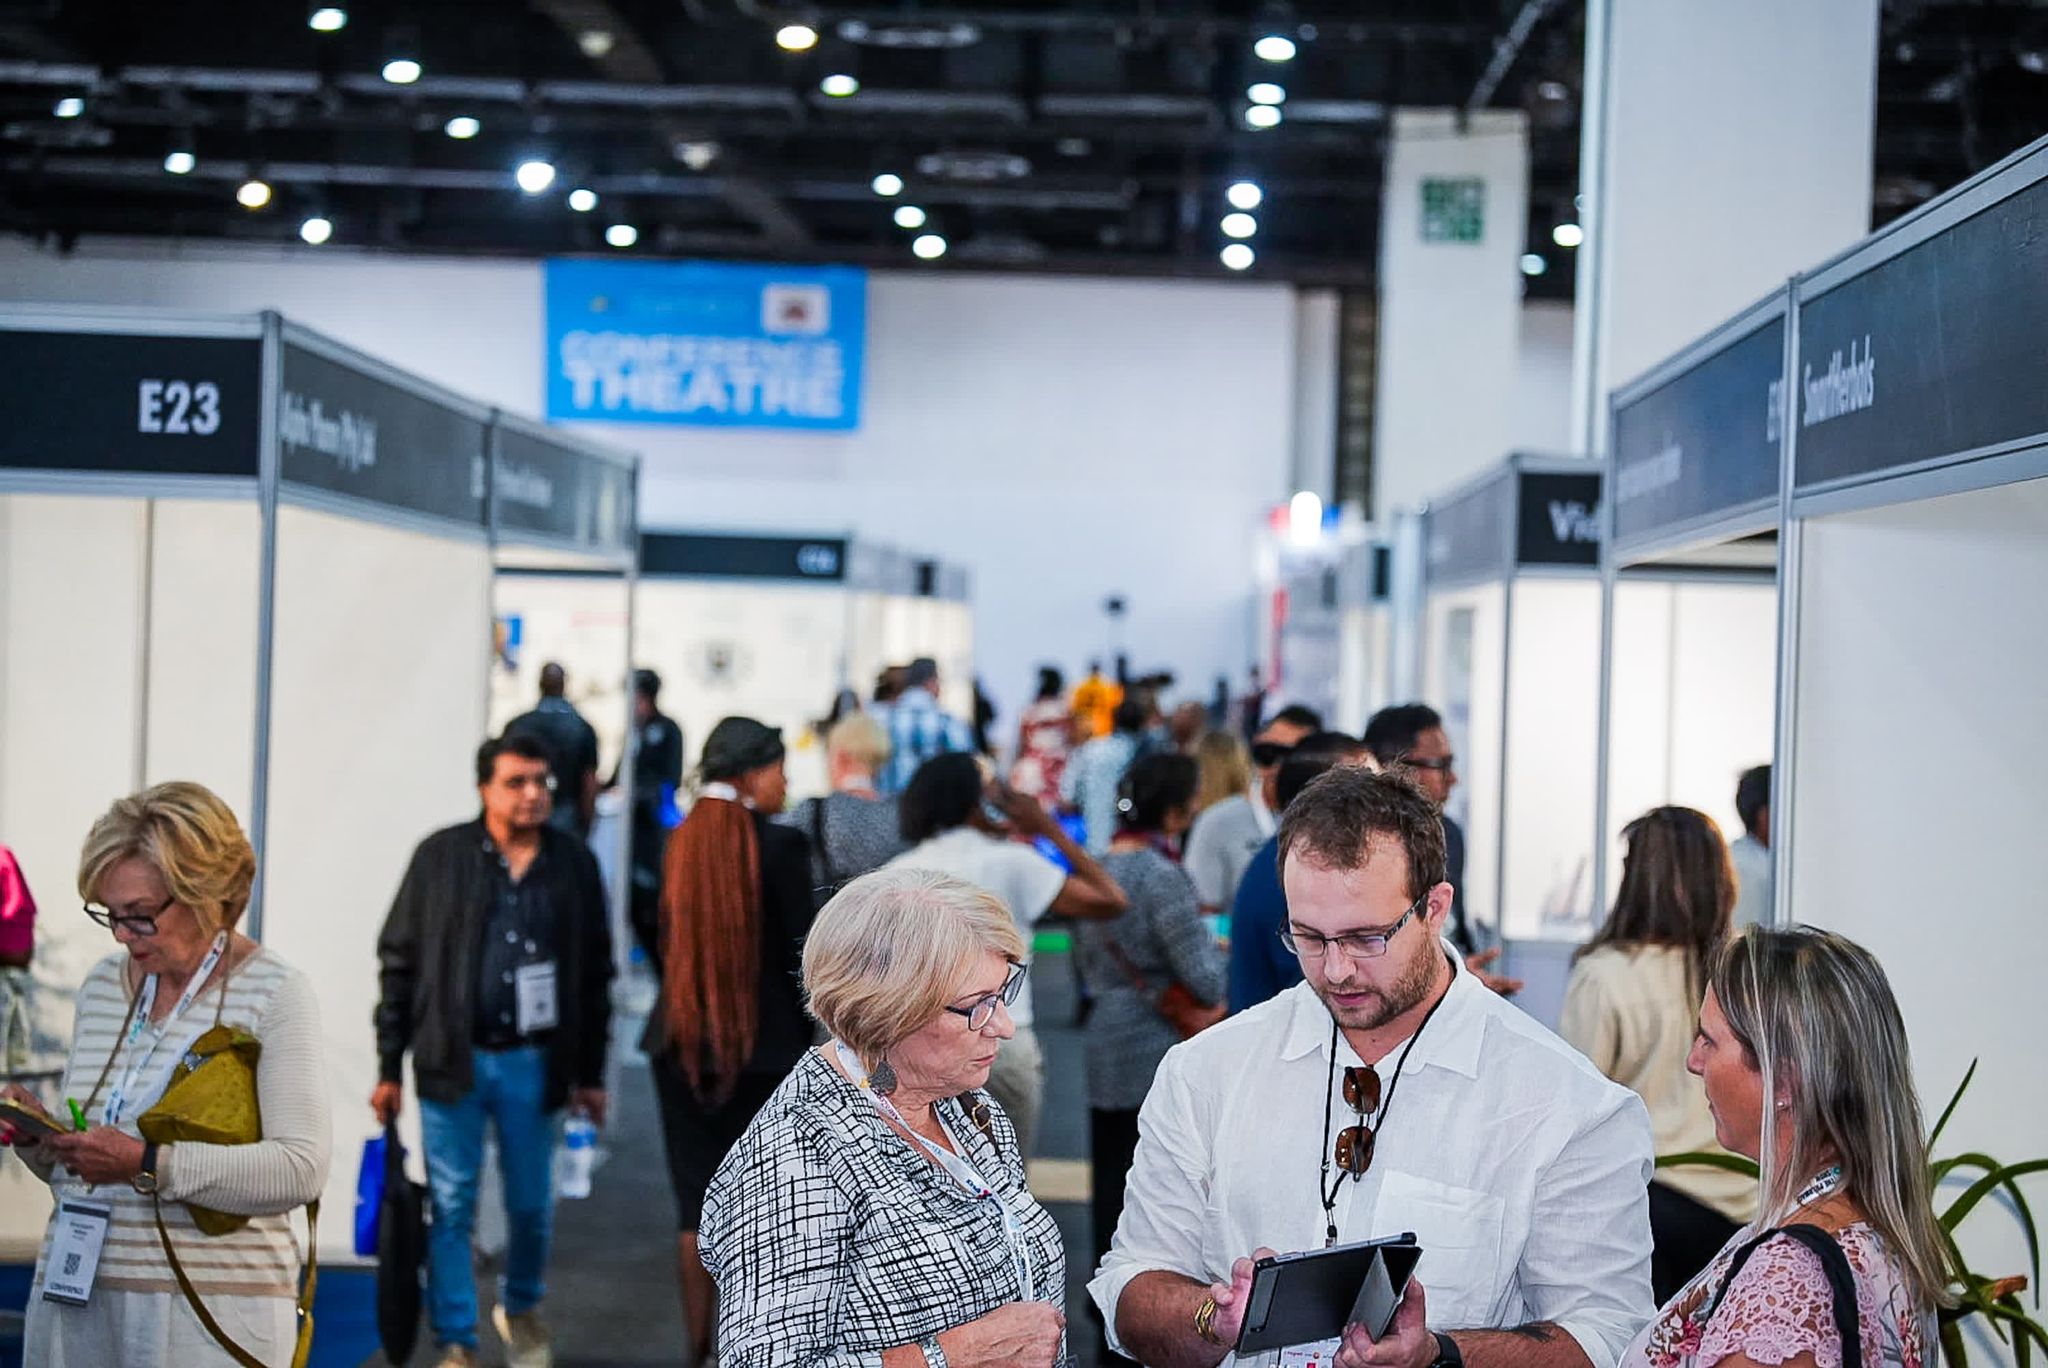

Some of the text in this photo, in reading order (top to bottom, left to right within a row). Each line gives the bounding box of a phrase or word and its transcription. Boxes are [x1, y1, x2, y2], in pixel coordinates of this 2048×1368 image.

[560, 330, 842, 374] CONFERENCE
[138, 378, 221, 436] E23
[564, 364, 843, 418] THEATRE
